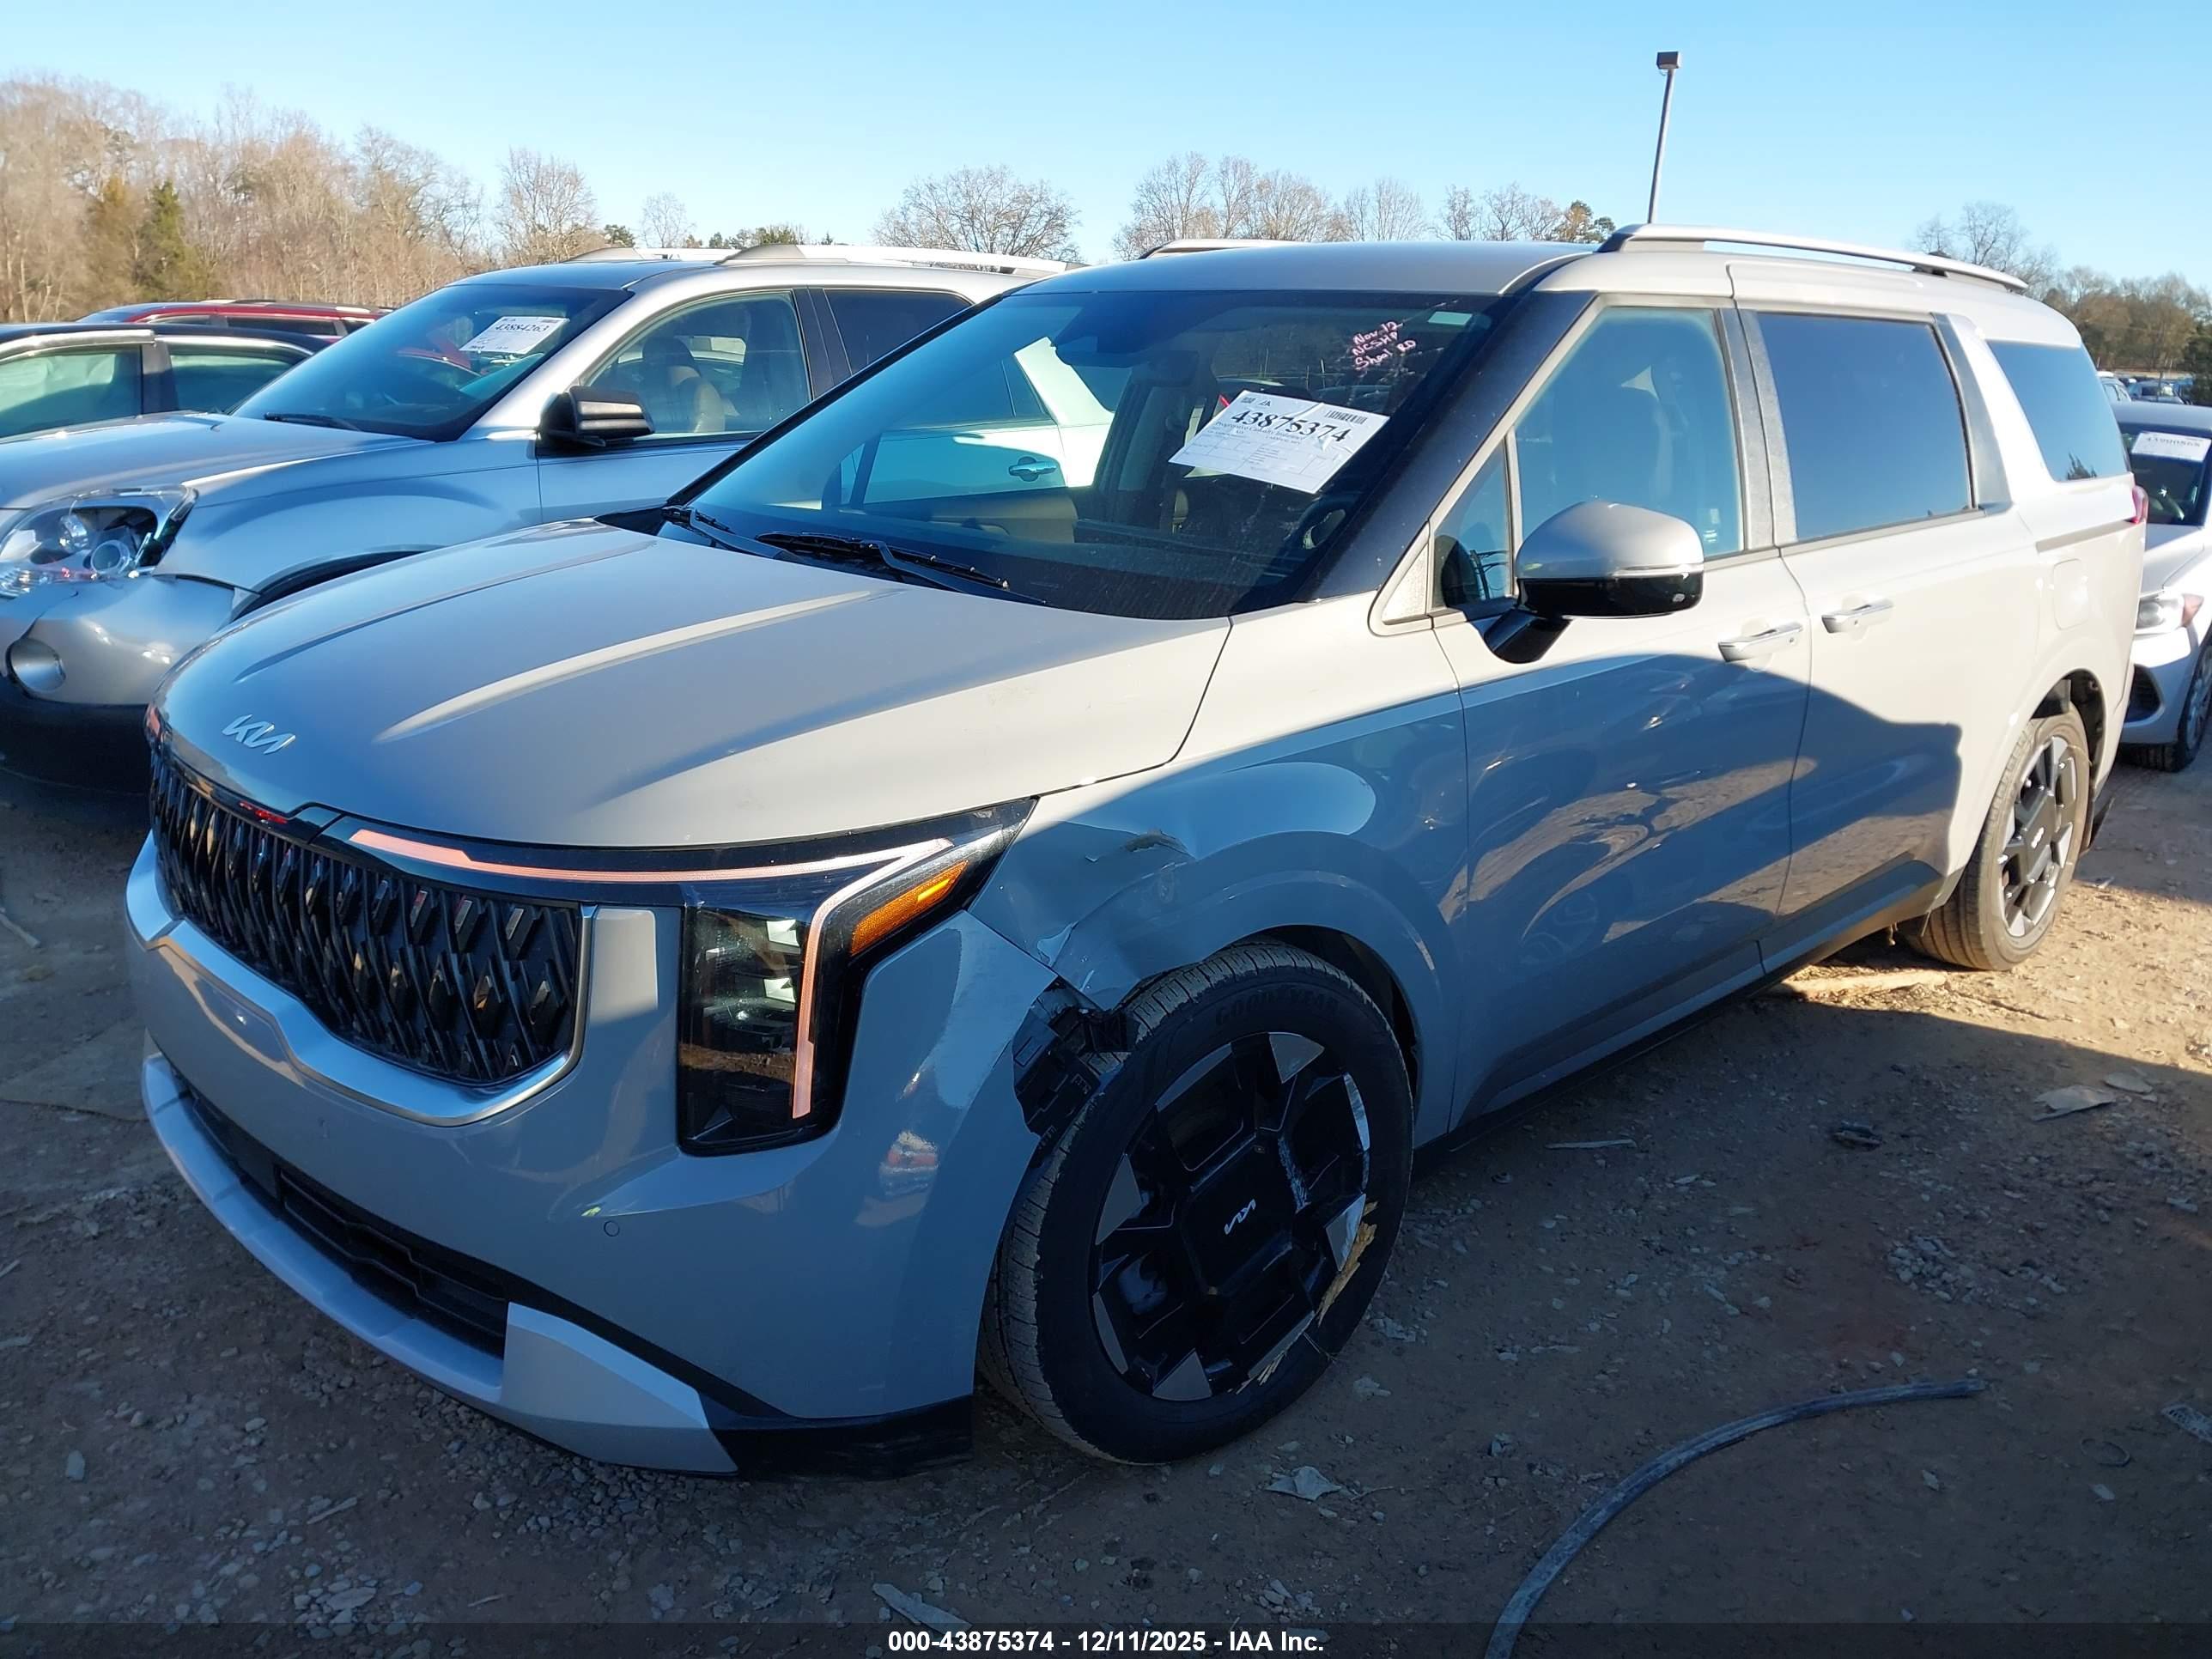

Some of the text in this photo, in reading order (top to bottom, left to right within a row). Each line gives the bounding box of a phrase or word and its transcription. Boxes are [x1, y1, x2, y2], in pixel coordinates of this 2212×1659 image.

[1352, 331, 1378, 345] Nov
[1231, 410, 1352, 443] 43875374
[222, 714, 296, 755] KIA
